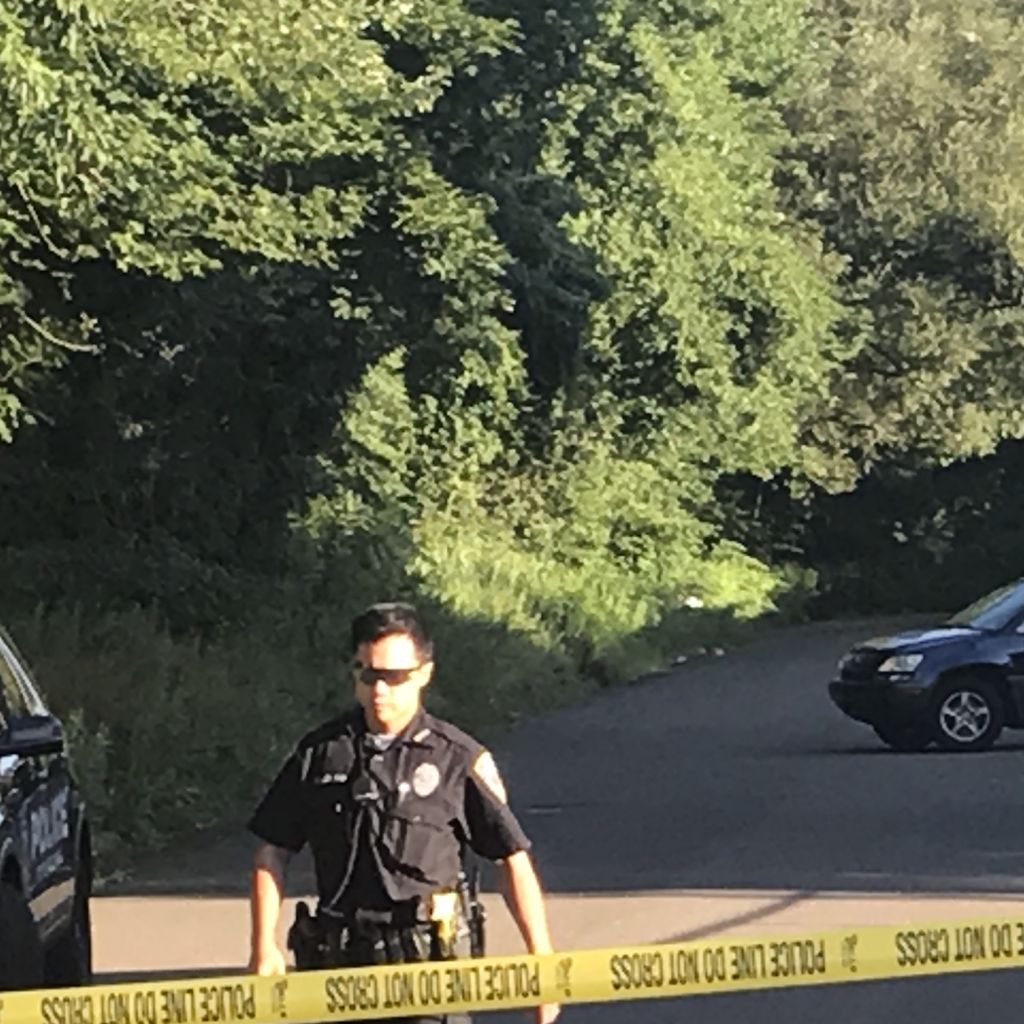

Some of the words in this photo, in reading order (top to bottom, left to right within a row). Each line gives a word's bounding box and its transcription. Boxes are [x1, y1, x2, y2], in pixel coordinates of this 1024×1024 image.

[771, 939, 826, 977] POLICE
[895, 928, 949, 966] CROSS
[954, 925, 985, 961] NOT
[990, 923, 1012, 958] DO
[610, 951, 663, 990] CROSS
[669, 948, 699, 985] NOT
[703, 947, 726, 983] DO
[731, 944, 765, 979] LINE
[325, 974, 377, 1013] CROSS
[383, 971, 414, 1009] NOT
[418, 970, 440, 1005] DO
[446, 967, 481, 1002] LINE
[485, 962, 540, 1000] POLICE
[161, 989, 195, 1024] LINE
[201, 984, 255, 1022] POLICE
